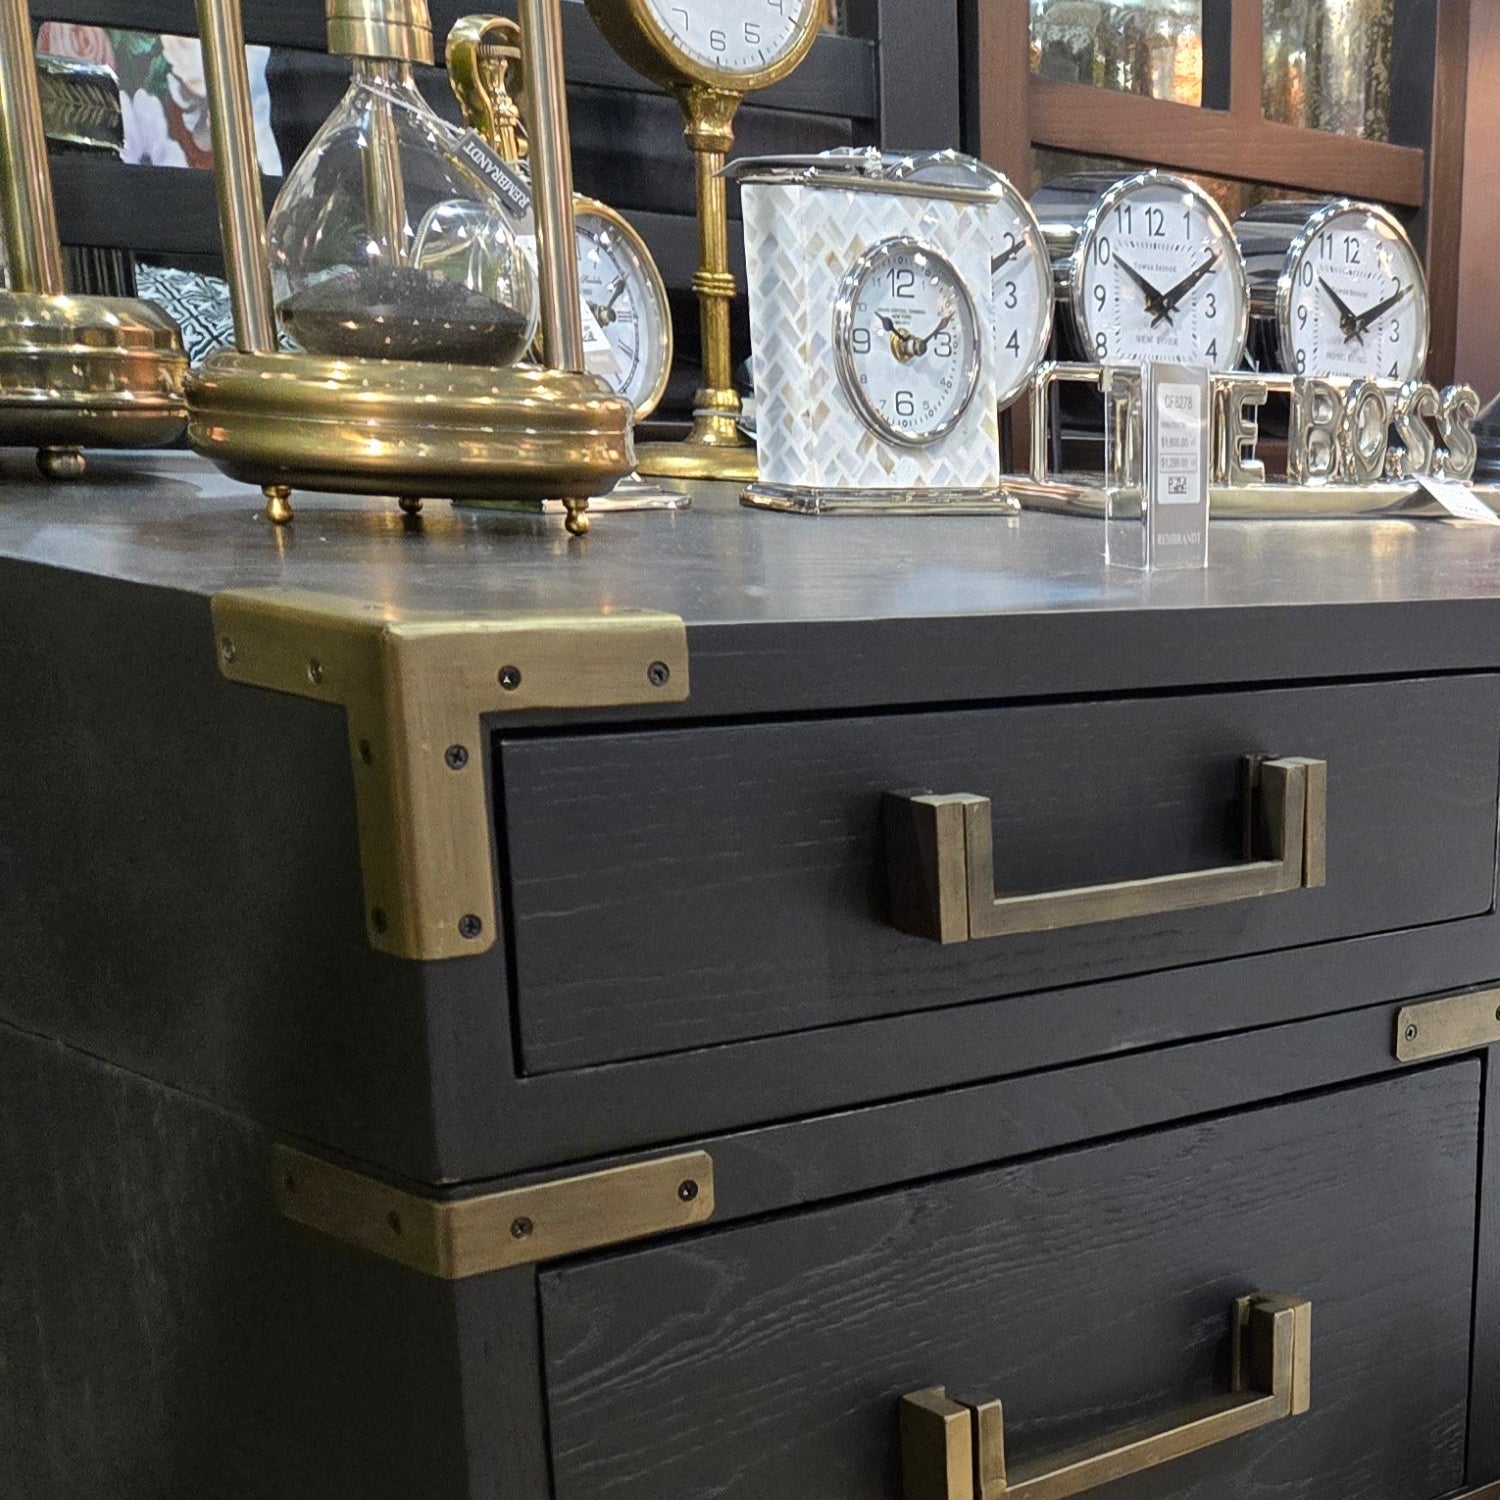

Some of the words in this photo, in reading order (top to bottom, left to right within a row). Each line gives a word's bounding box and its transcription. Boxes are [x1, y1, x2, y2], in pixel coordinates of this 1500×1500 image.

[671, 7, 688, 31] 7
[709, 29, 726, 51] 6
[744, 22, 761, 44] 5
[462, 141, 531, 209] REMBRANDT
[1114, 205, 1132, 235] 11
[1144, 207, 1166, 237] 12
[1183, 209, 1190, 240] 1
[1093, 236, 1111, 266] 10
[1317, 232, 1333, 260] 11
[1343, 235, 1361, 264] 12
[886, 268, 915, 298] 12
[1297, 260, 1314, 287] 10
[1004, 281, 1018, 309] 3
[1093, 284, 1107, 312] 9
[1204, 292, 1217, 319] 3
[1297, 304, 1308, 330] 9
[1389, 318, 1400, 343] 3
[852, 328, 871, 354] 9
[933, 331, 953, 358] 3
[1005, 328, 1020, 358] 4
[1095, 332, 1108, 359] 8
[1204, 337, 1218, 364] 4
[1296, 348, 1306, 374] 8
[1387, 361, 1399, 379] 4
[895, 390, 914, 416] 6
[1290, 378, 1481, 488] BOSS
[1157, 531, 1201, 545] REMBRANDT
